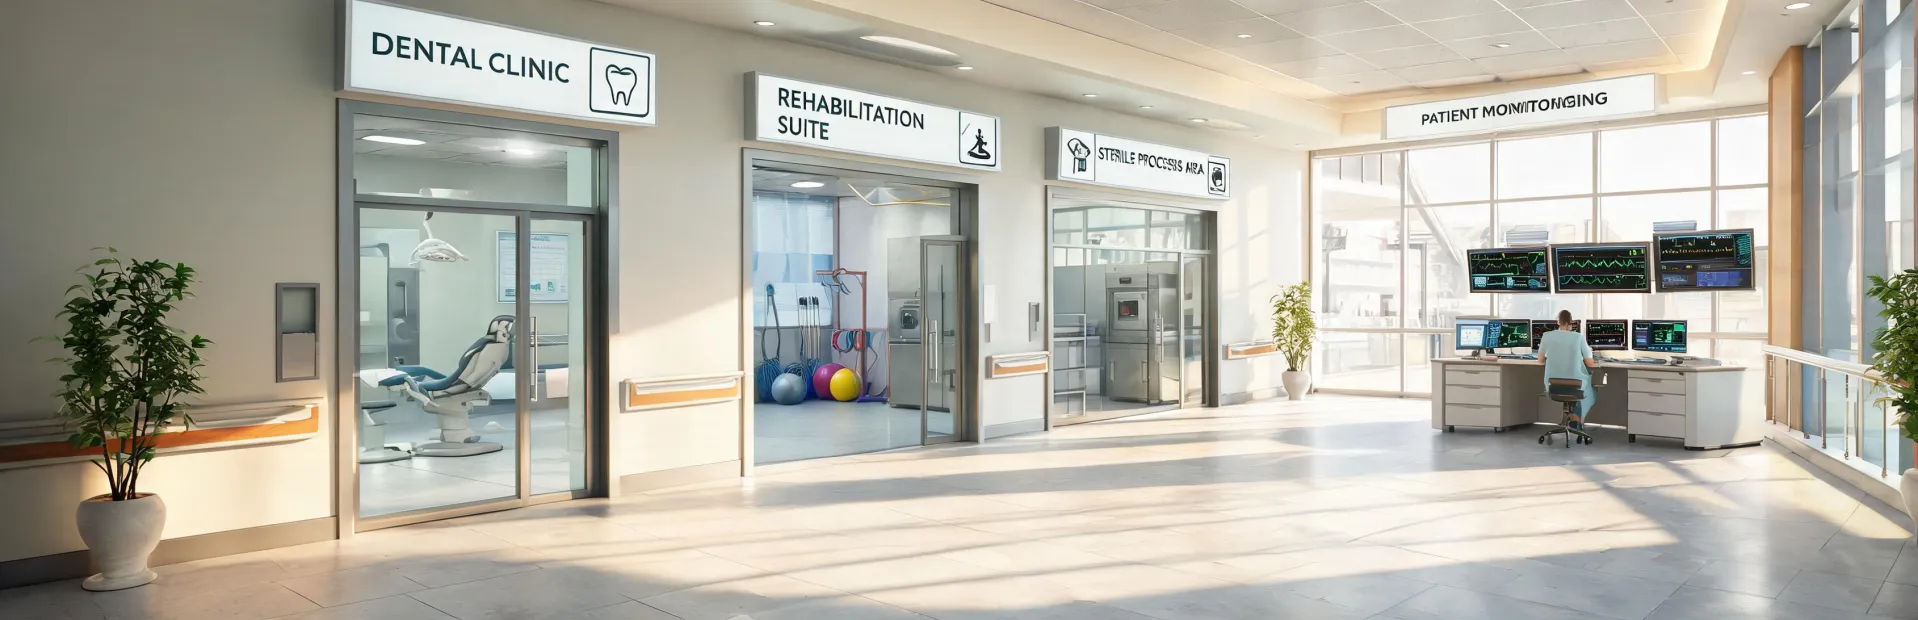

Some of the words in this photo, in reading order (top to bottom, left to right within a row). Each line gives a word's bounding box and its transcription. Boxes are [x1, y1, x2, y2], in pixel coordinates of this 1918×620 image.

[372, 31, 483, 71] DENTAL
[488, 52, 570, 84] CLINIC
[778, 87, 924, 130] REHABILITATION
[1421, 107, 1479, 125] PATIENT
[777, 115, 829, 141] SUITE
